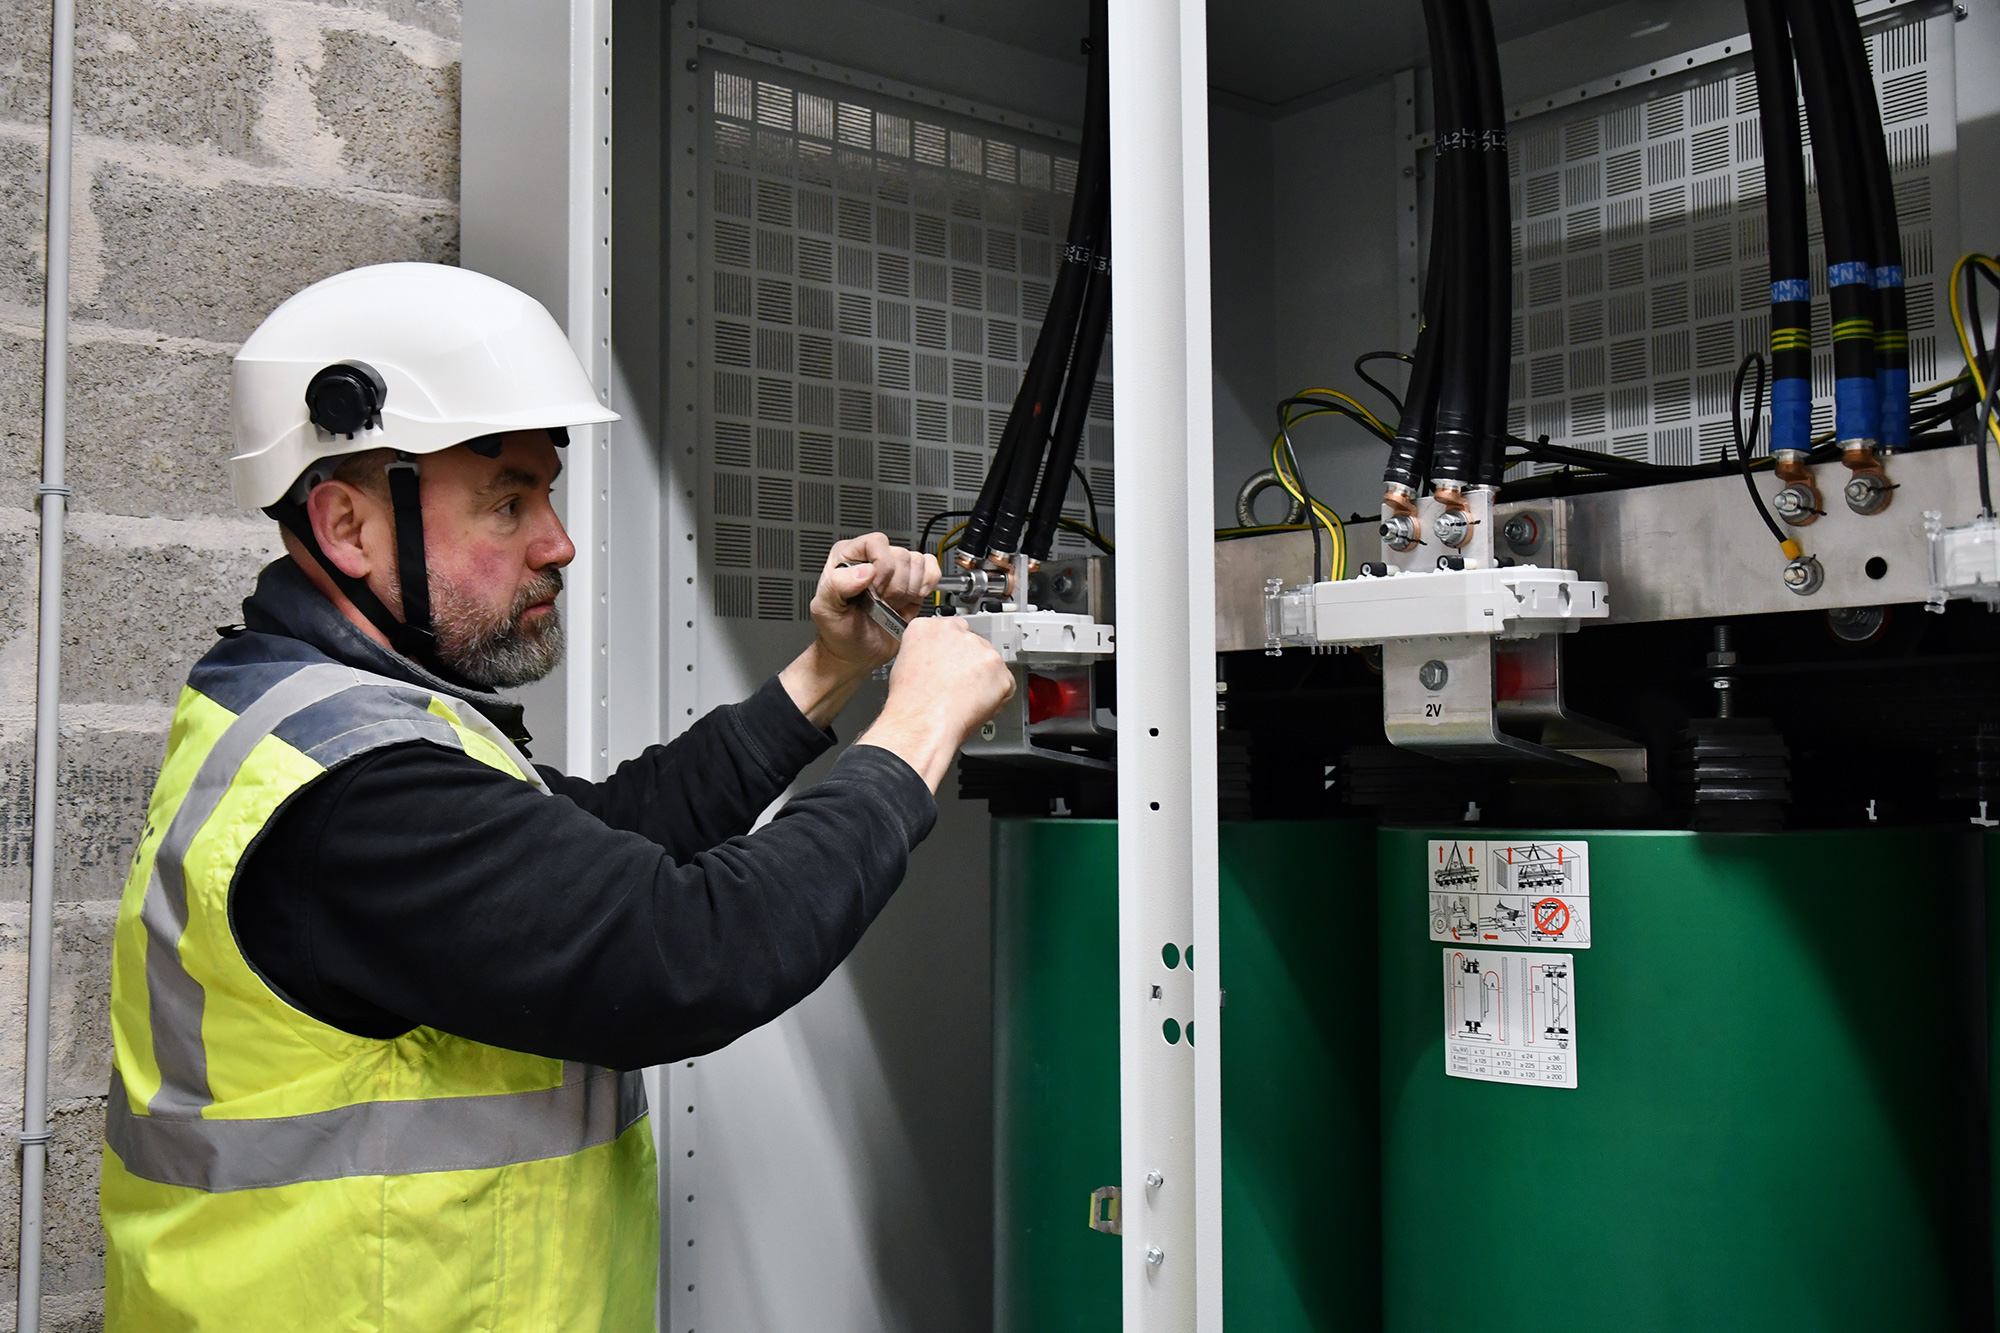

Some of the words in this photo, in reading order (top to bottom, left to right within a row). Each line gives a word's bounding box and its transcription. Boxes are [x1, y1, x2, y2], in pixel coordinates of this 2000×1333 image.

[1841, 267, 1853, 281] N
[1425, 703, 1442, 718] 2V
[982, 723, 994, 735] 2W
